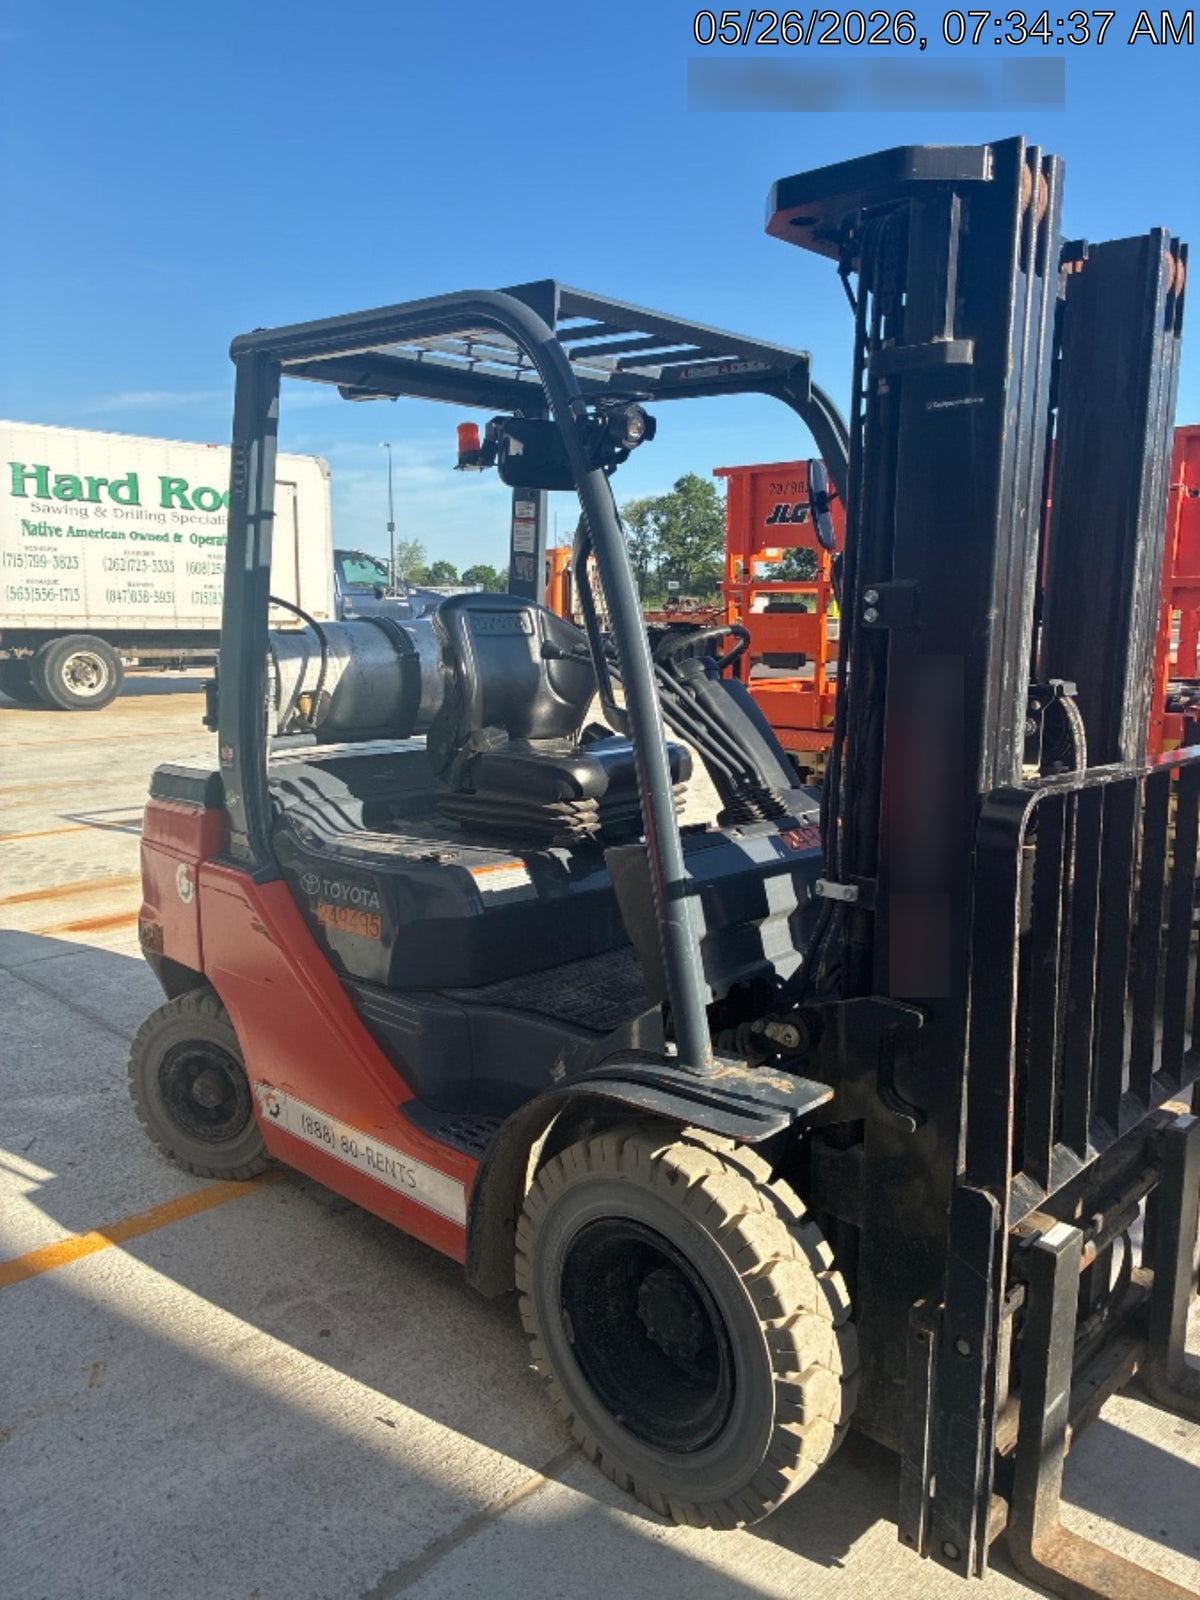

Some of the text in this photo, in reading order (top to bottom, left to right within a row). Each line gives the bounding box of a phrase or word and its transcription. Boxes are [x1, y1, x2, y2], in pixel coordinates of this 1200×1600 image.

[7, 461, 142, 507] Hard
[30, 501, 228, 526] Sawing & Drilling Speciali
[765, 503, 811, 525] JLG
[21, 519, 63, 538] Native
[66, 525, 127, 541] American
[129, 531, 170, 544] Owned
[173, 533, 184, 544] &
[322, 880, 379, 909] TOYOTA
[301, 1113, 417, 1189] (888) 80-RENTS
